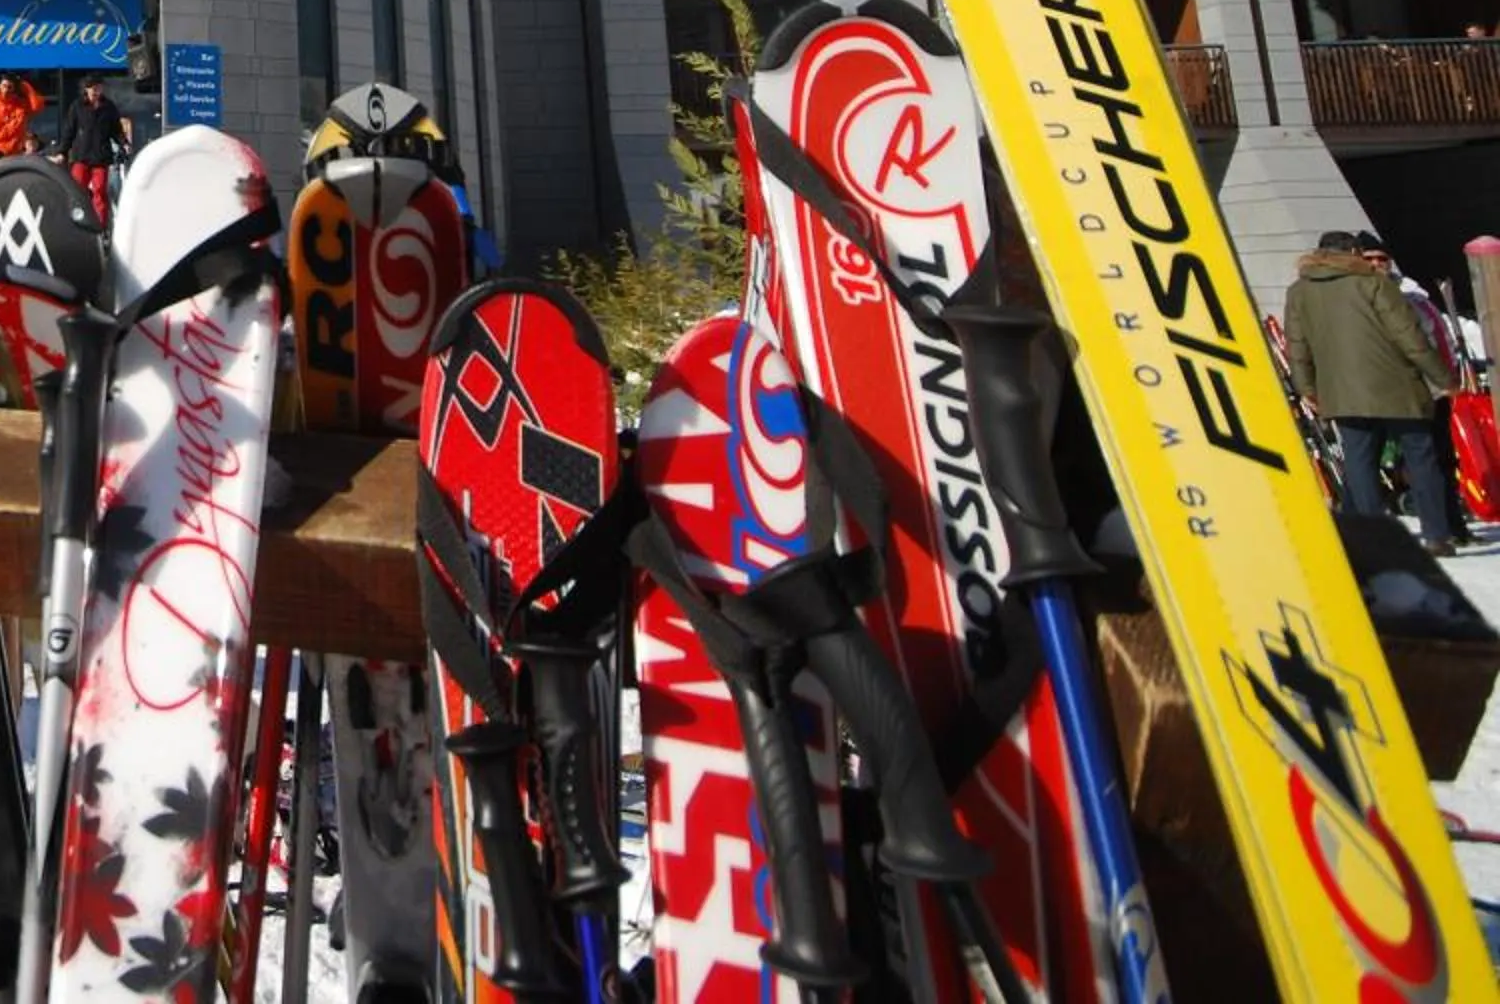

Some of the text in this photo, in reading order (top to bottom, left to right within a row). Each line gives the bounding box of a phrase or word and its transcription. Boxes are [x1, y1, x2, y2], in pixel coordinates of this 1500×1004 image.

[302, 214, 356, 380] RC
[122, 296, 262, 711] Dynastar
[1178, 483, 1220, 540] RS
